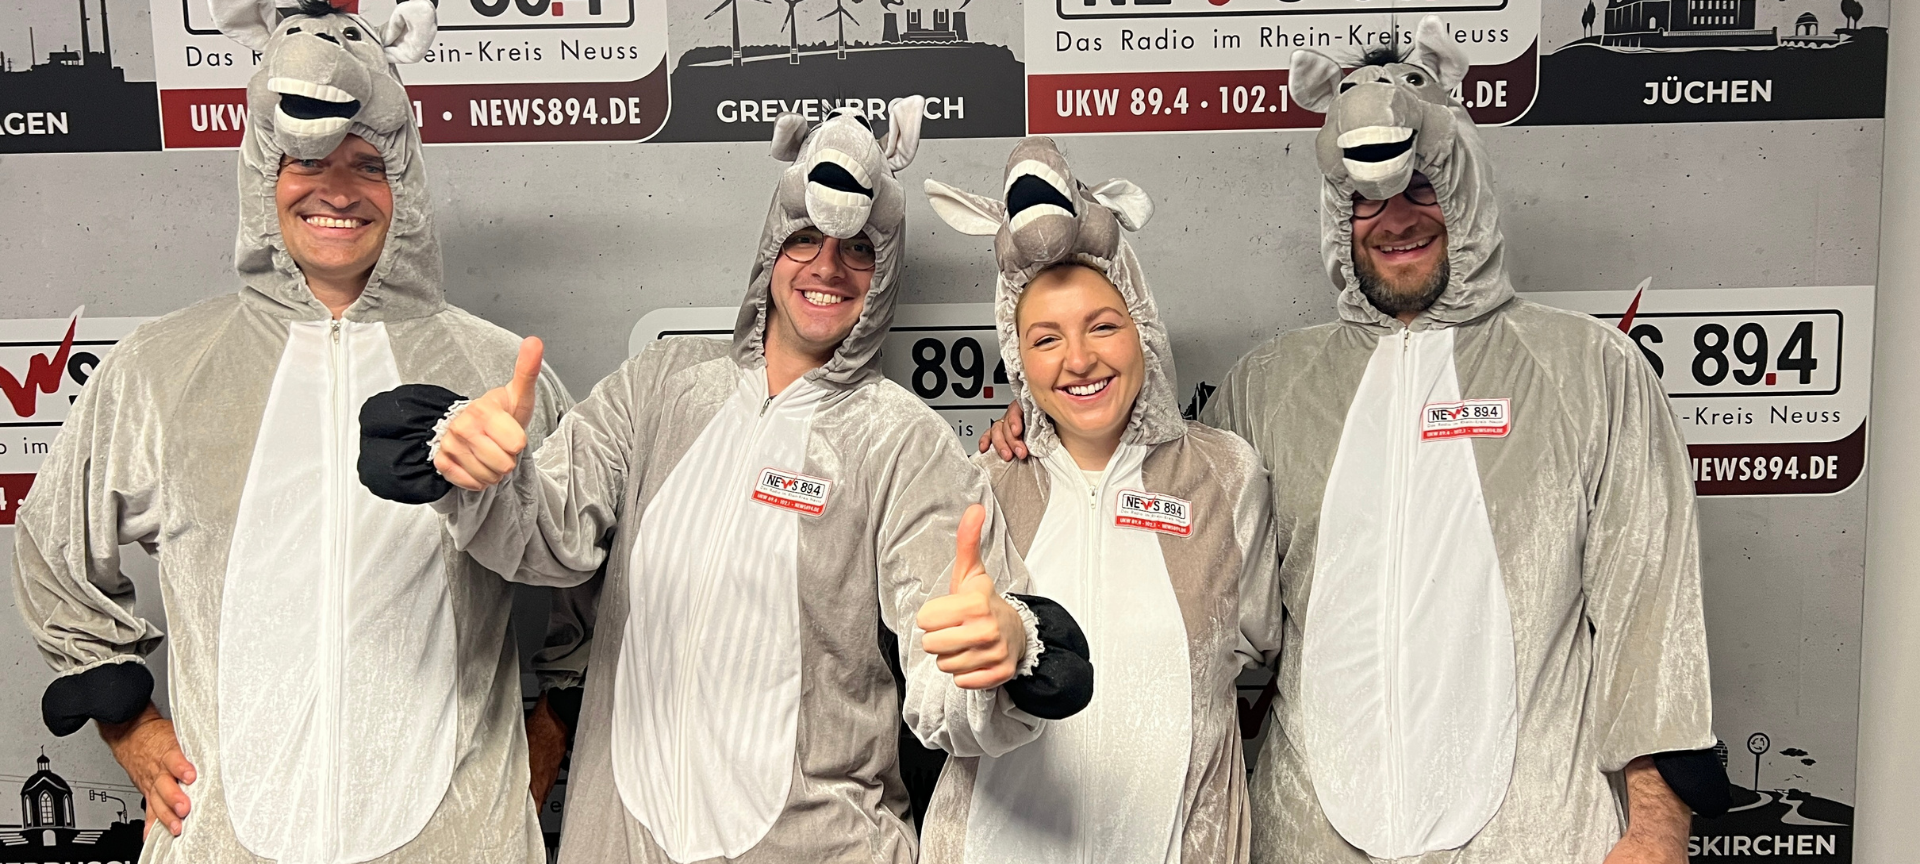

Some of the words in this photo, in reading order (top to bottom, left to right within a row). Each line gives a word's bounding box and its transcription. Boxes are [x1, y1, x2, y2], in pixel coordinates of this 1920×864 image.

[1056, 30, 1102, 52] Das
[1121, 27, 1195, 51] Radio
[1213, 28, 1241, 49] im
[1260, 24, 1412, 48] Rhein-Kreis
[1446, 23, 1509, 44] euss
[186, 46, 233, 67] Das
[424, 40, 542, 63] ein-Kreis
[560, 39, 638, 61] Neuss
[1056, 88, 1120, 117] UKW
[1130, 87, 1189, 116] 89.4
[1219, 84, 1288, 114] 102.1
[1643, 75, 1772, 105] JÜCHEN
[0, 112, 69, 135] GEN
[190, 104, 248, 132] UKW
[470, 97, 641, 127] NEWS894.DE
[1691, 320, 1818, 387] 89.4
[1432, 404, 1470, 420] NEWS
[1682, 406, 1753, 425] -Kreis
[1770, 405, 1841, 424] Neuss
[23, 436, 49, 455] im
[766, 474, 799, 491] NEWS
[1126, 495, 1160, 511] NEWS
[1688, 834, 1836, 857] SKIRCHEN
